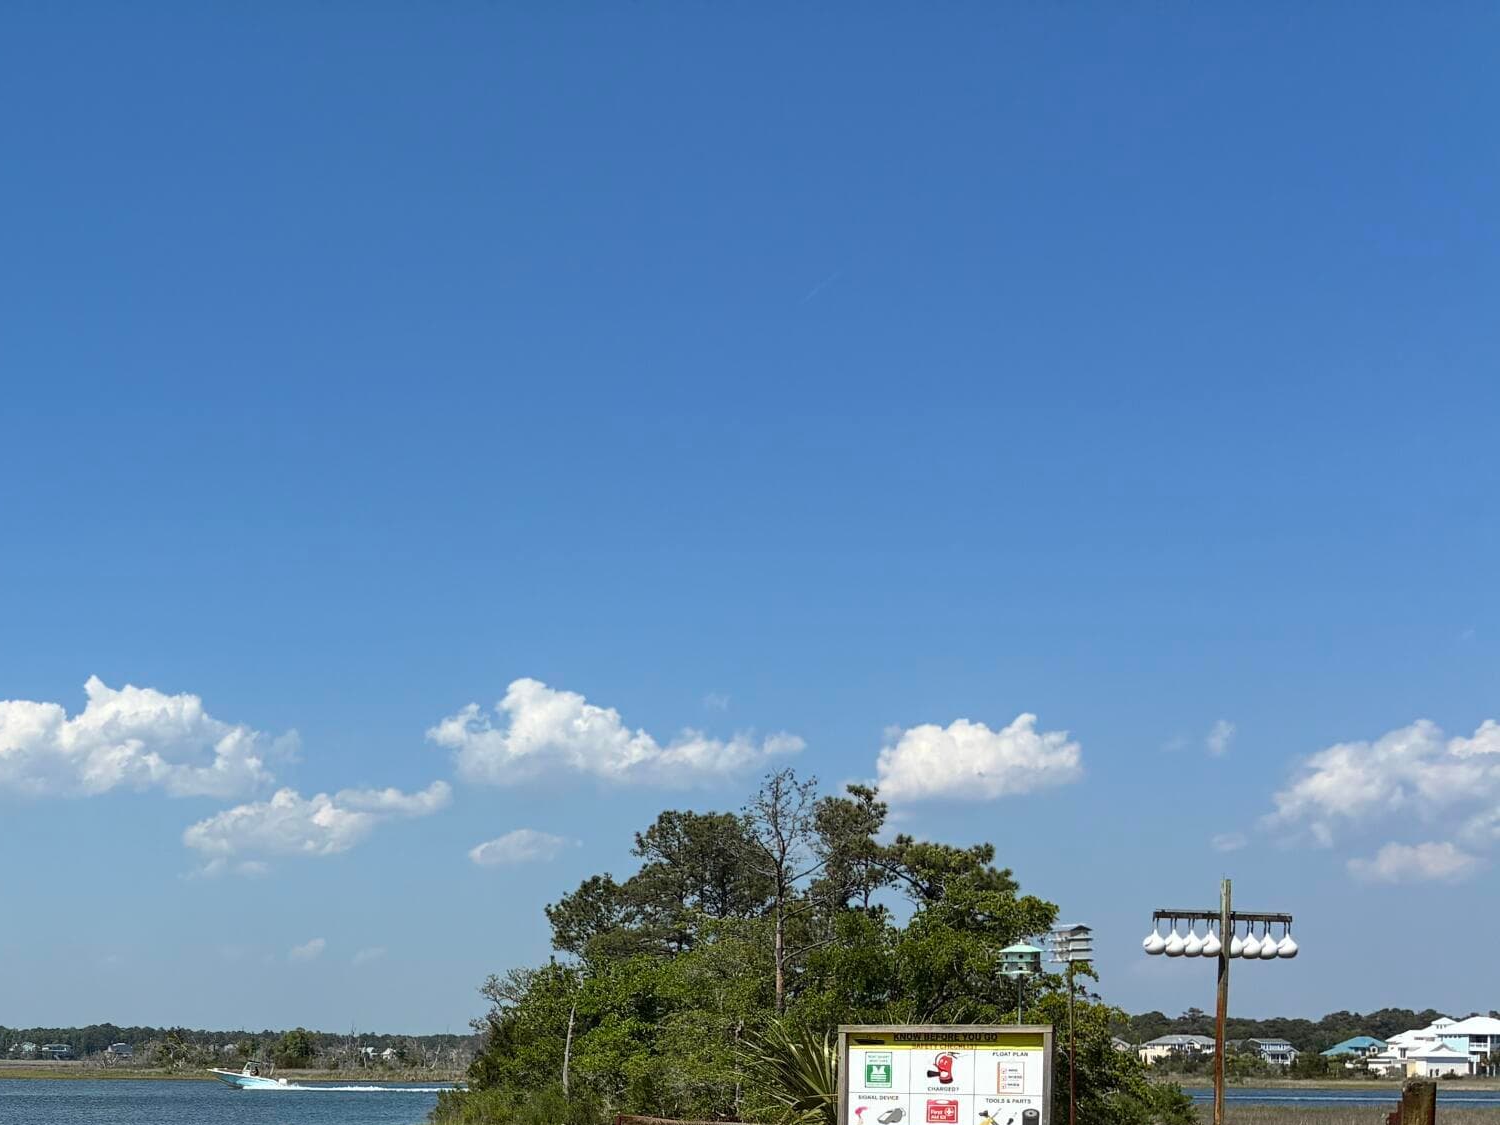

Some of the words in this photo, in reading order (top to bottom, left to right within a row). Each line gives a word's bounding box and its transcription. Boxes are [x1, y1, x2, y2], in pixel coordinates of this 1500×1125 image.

[893, 1032, 922, 1041] KNOW
[924, 1032, 961, 1041] BEFORE
[963, 1033, 982, 1042] YOU
[985, 1033, 998, 1042] GO
